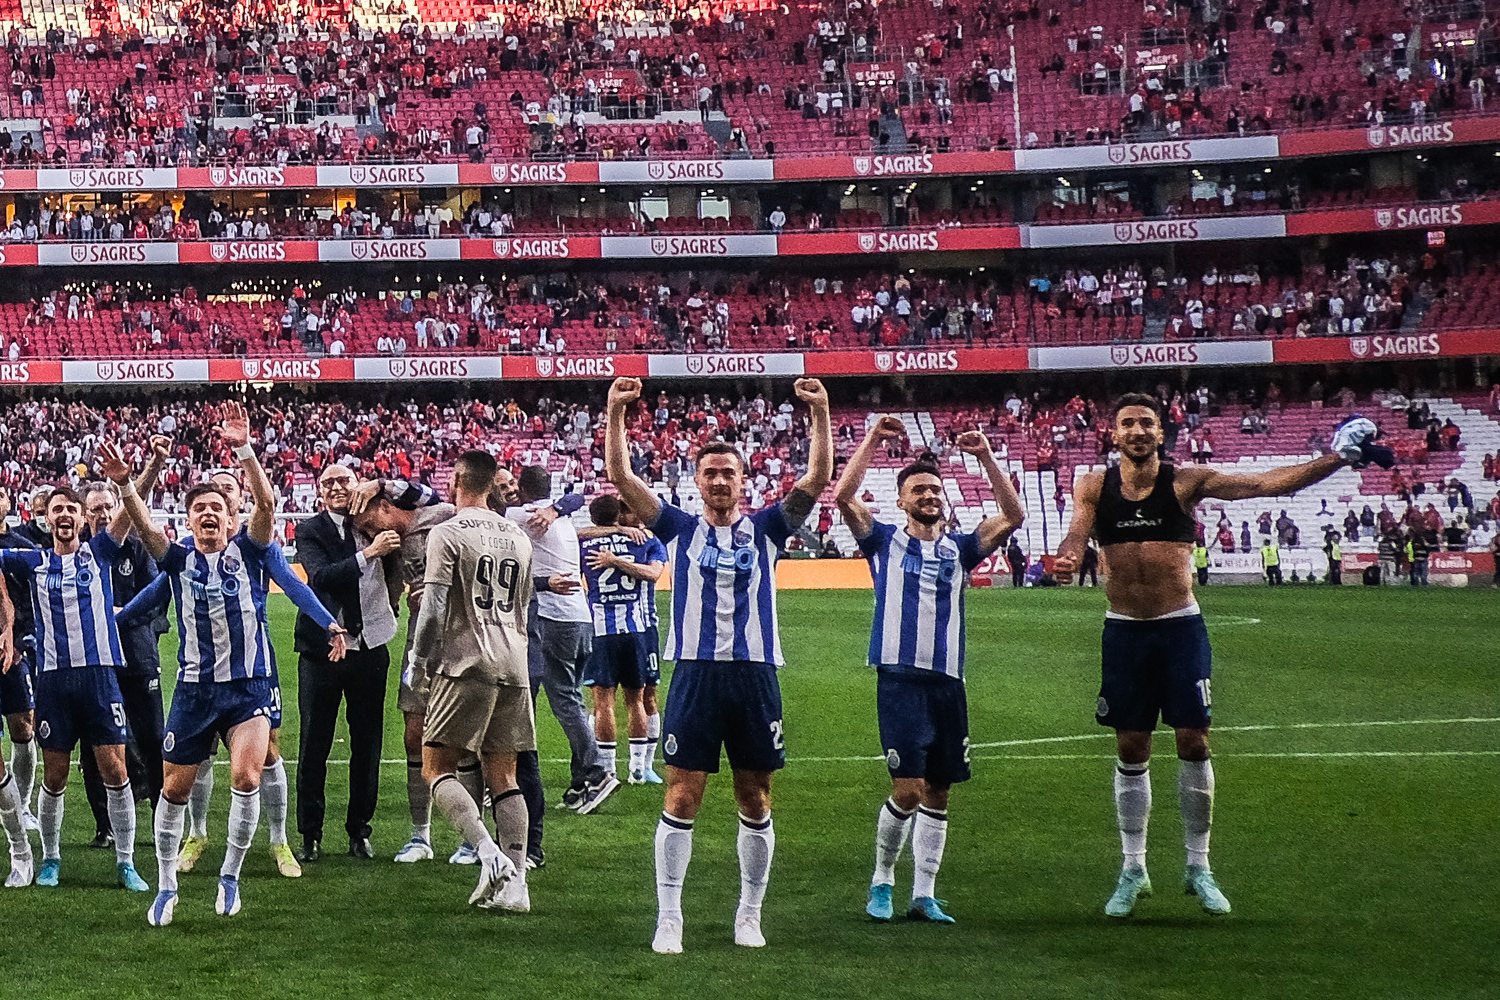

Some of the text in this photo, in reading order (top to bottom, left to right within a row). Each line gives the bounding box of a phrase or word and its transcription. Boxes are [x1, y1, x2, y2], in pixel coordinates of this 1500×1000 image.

[1388, 122, 1454, 145] SAGRES
[1130, 142, 1192, 163] SAGRES
[369, 165, 424, 184] SAGRES
[510, 163, 566, 183] SAGRES
[668, 160, 724, 179] SAGRES
[874, 154, 933, 175] SAGRES
[89, 169, 144, 187] SAGRES
[228, 167, 285, 186] SAGRES
[1396, 204, 1463, 228] SAGRES
[878, 230, 939, 252] SAGRES
[1136, 221, 1198, 242] SAGRES
[90, 244, 146, 262] SAGRES
[229, 240, 286, 261] SAGRES
[370, 240, 428, 259] SAGRES
[512, 237, 569, 258] SAGRES
[670, 237, 728, 256] SAGRES
[1134, 342, 1199, 365] SAGRES
[1372, 333, 1440, 357] SAGRES
[116, 361, 175, 380] SAGRES
[262, 358, 320, 379] SAGRES
[408, 358, 468, 378] SAGRES
[556, 356, 615, 376] SAGRES
[706, 355, 766, 374] SAGRES
[896, 350, 958, 372] SAGRES
[1116, 518, 1164, 528] CATAPULT
[698, 544, 754, 570] MEO
[900, 554, 956, 582] MEO
[45, 568, 94, 590] MEO
[190, 576, 240, 602] MEO
[474, 554, 520, 614] 99
